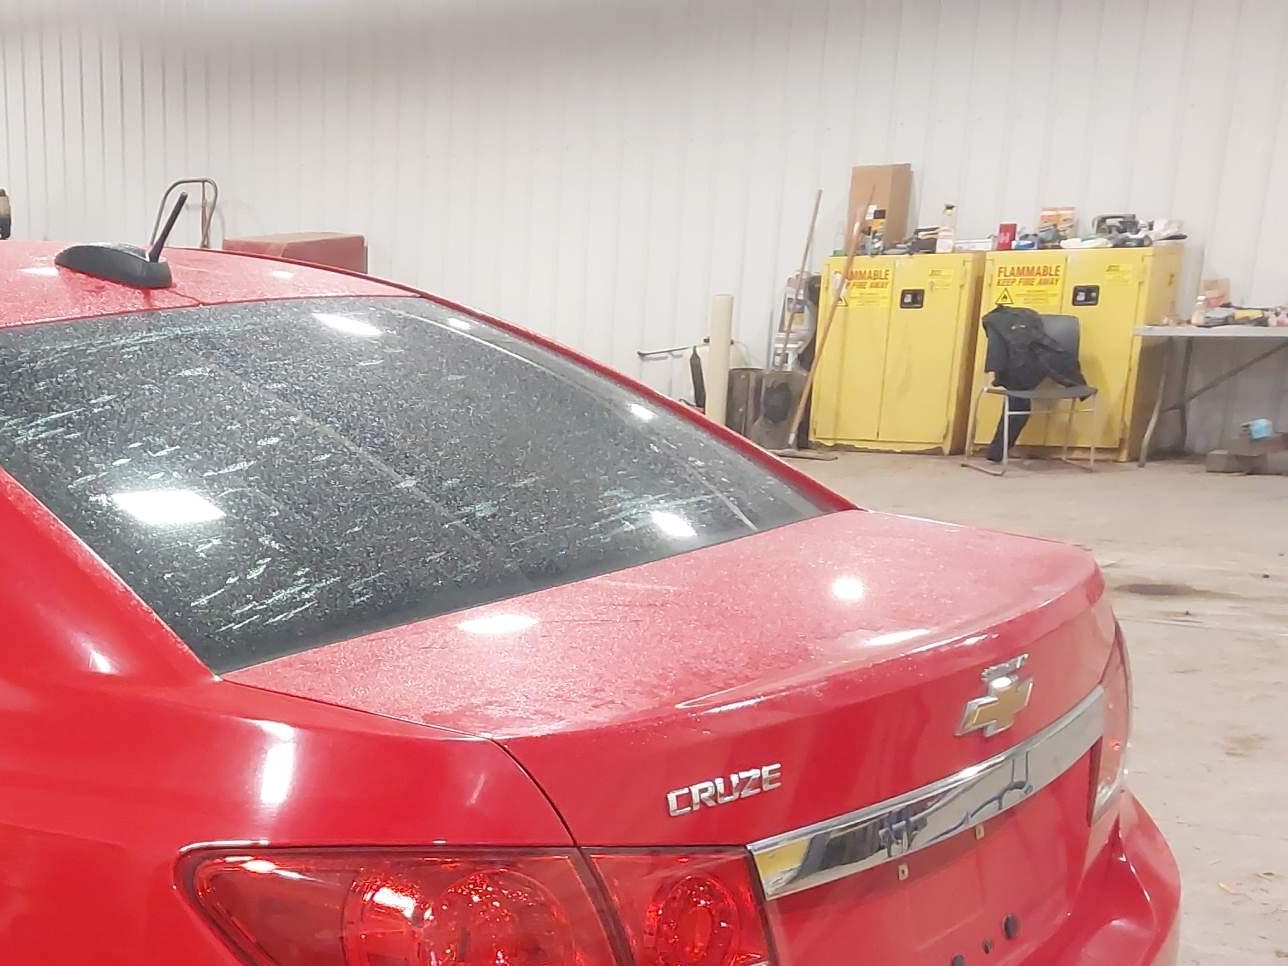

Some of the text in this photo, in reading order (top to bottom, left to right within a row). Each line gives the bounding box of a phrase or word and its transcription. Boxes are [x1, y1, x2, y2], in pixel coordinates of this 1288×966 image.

[997, 265, 1061, 277] FLAMMABLE
[997, 277, 1061, 287] KEEP FIRE AWAY
[666, 762, 782, 817] CRUZE
